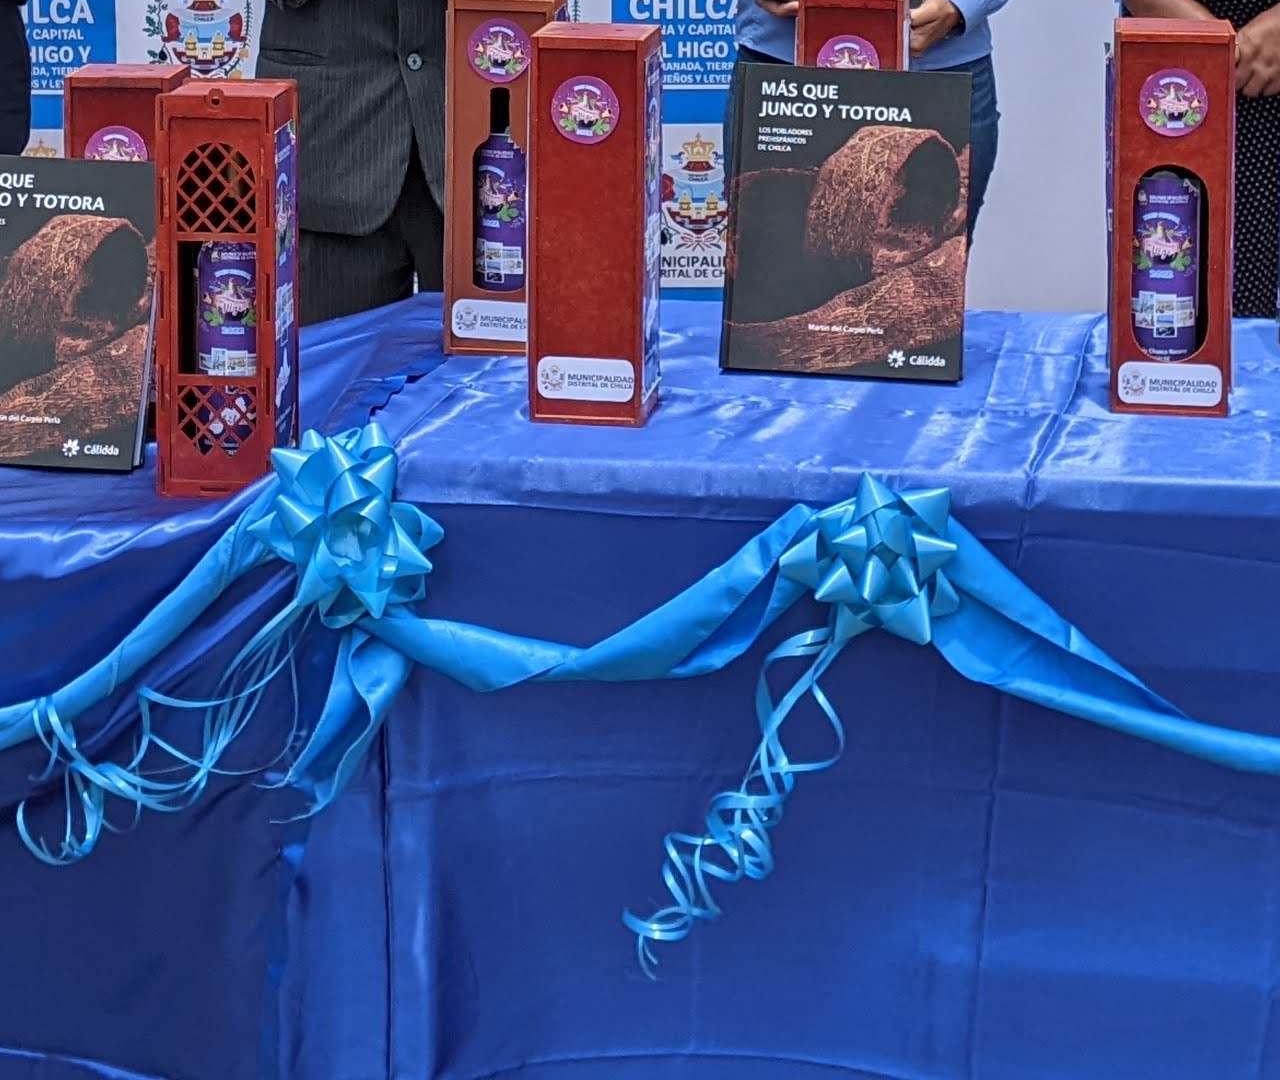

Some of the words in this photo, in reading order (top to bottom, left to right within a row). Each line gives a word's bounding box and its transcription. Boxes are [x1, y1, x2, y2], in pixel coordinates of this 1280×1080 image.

[33, 29, 84, 40] CAPITAL
[678, 41, 728, 57] HIGO
[762, 79, 797, 97] MÁS
[803, 84, 838, 100] QUE
[759, 101, 817, 118] JUNCO
[822, 104, 834, 118] Y
[838, 105, 912, 122] TOTORA
[772, 127, 813, 136] POBLADORES
[758, 143, 767, 151] DE
[0, 173, 34, 189] QUE
[17, 193, 28, 207] Y
[33, 194, 105, 211] TOTORA
[567, 374, 634, 383] MUNICIPALIDAD
[1149, 379, 1217, 388] MUNICIPALIDAD
